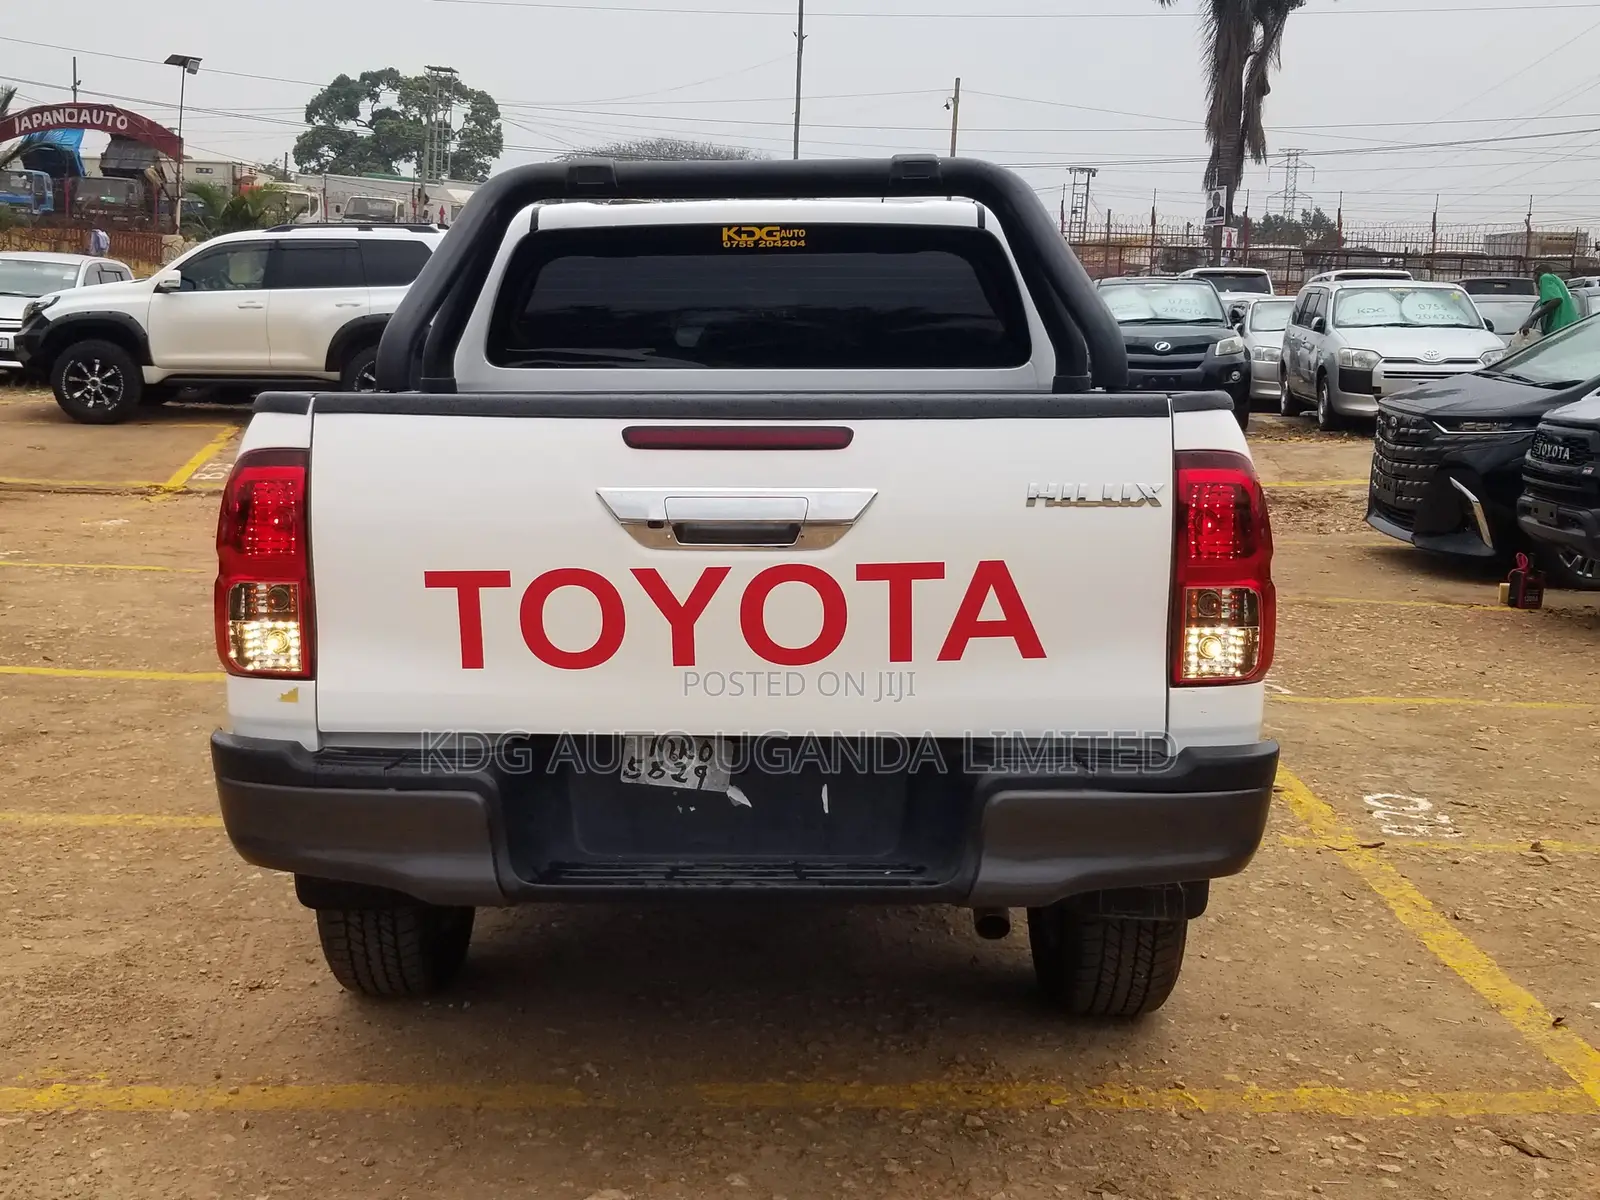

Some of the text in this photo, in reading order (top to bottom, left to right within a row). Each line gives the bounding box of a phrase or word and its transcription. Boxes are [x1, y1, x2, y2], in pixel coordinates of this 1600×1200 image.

[14, 108, 128, 134] JAPAN AUTO
[722, 226, 806, 241] KDG AUTO
[723, 239, 806, 248] 0755 204204
[1536, 441, 1570, 460] TOYOTA
[1026, 482, 1164, 507] HILUX
[424, 560, 1047, 670] TOYOTA
